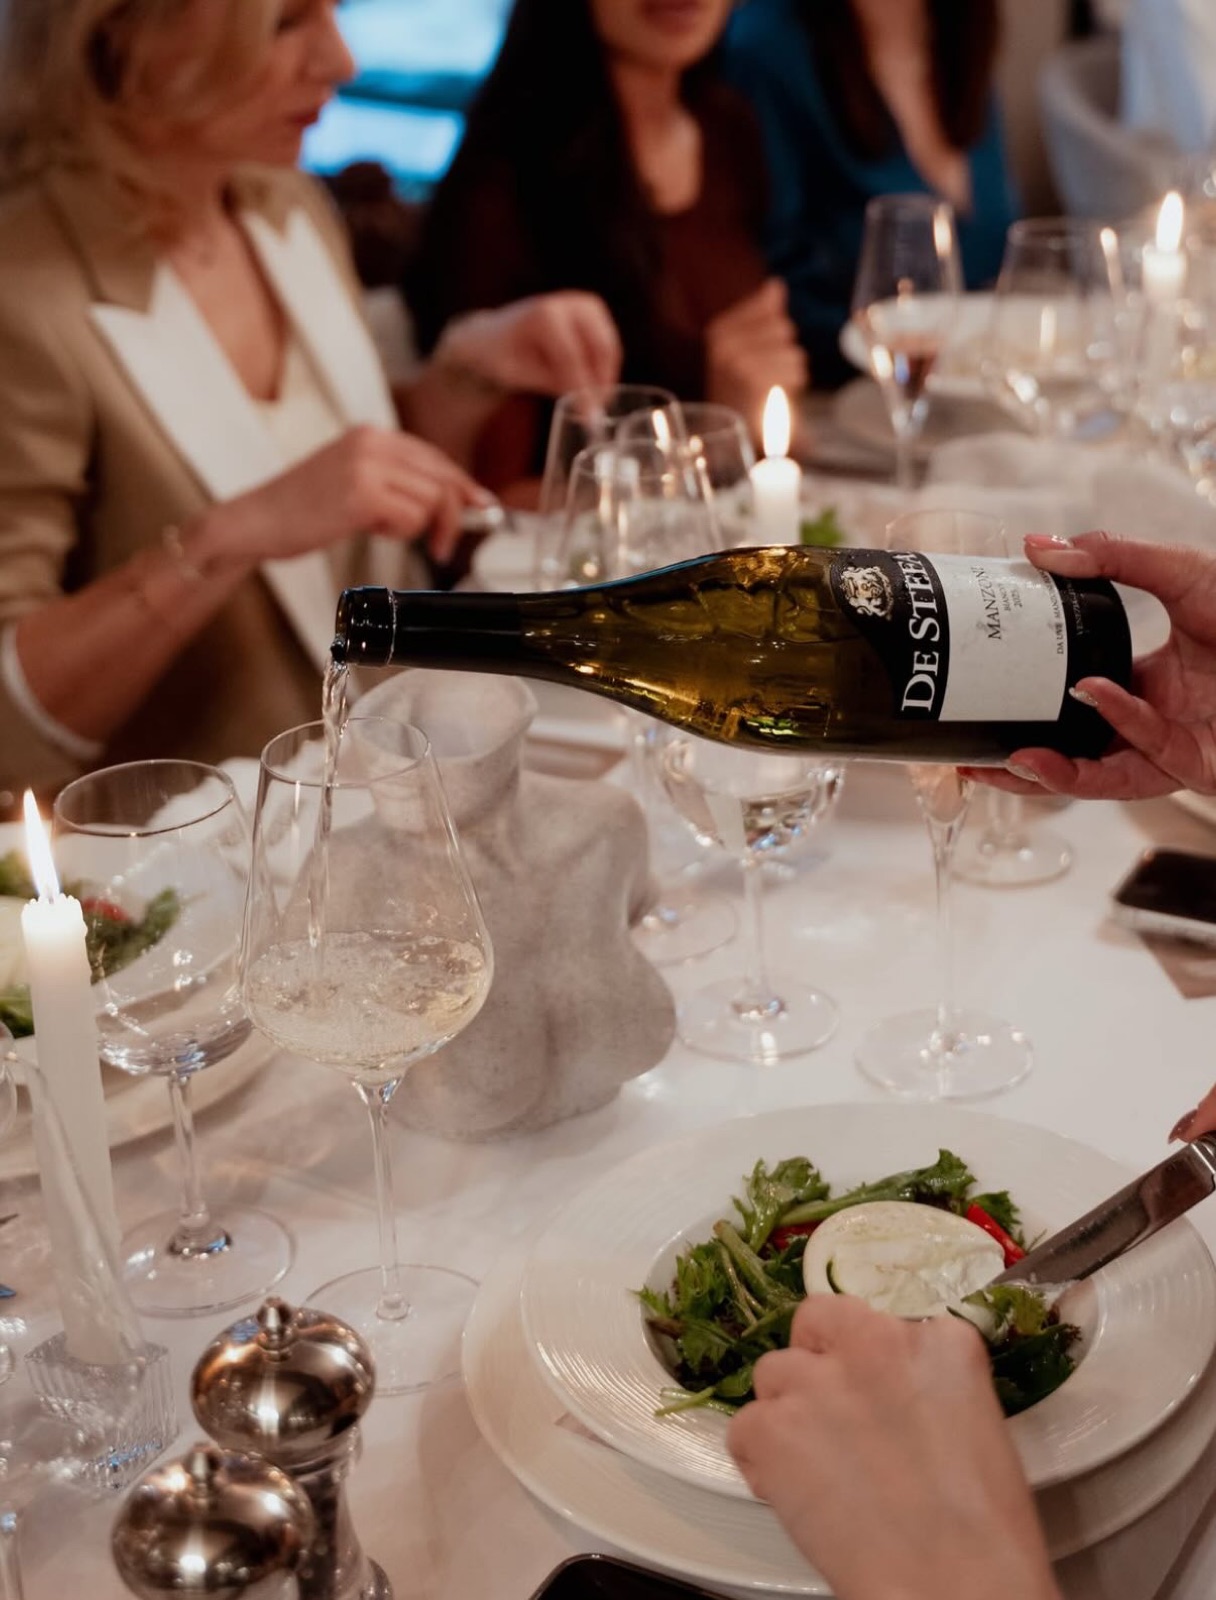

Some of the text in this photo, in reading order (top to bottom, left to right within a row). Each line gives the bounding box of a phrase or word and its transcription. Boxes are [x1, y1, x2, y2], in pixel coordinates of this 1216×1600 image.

[893, 552, 941, 712] DE STEFA
[970, 566, 1002, 640] MANZONI
[1056, 641, 1064, 655] DA
